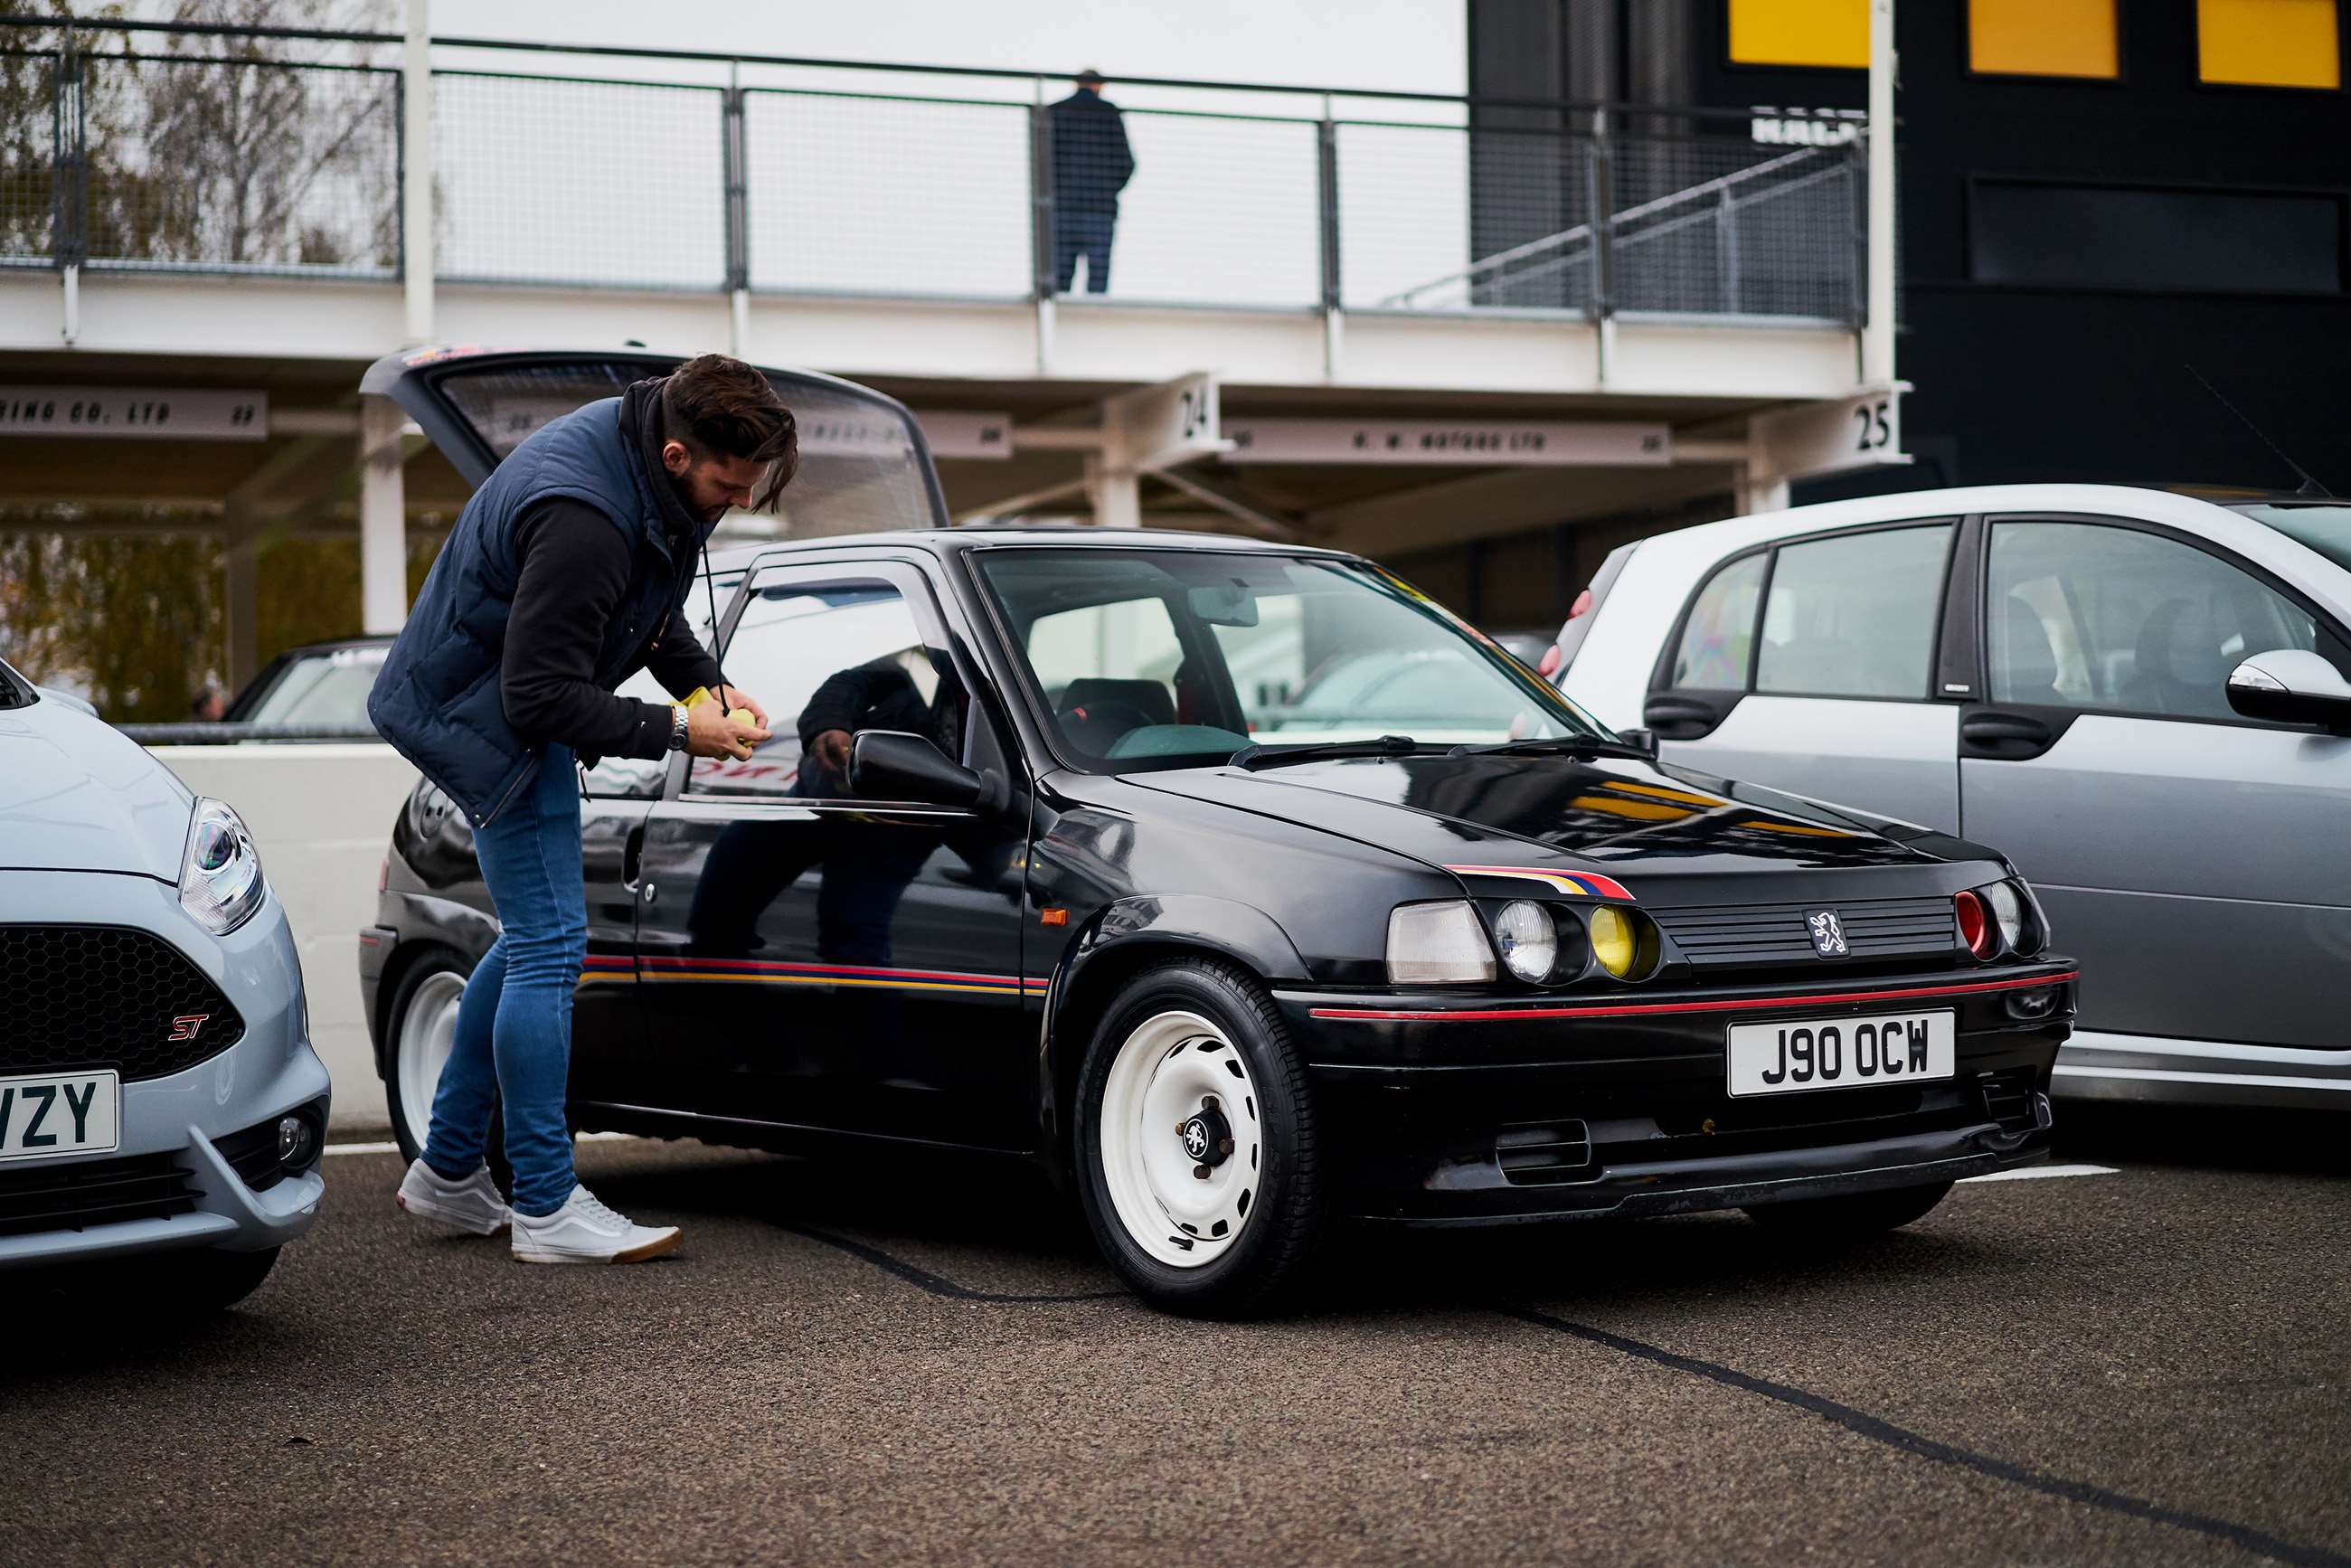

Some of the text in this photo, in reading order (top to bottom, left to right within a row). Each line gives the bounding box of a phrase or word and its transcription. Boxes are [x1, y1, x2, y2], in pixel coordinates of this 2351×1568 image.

[127, 401, 170, 425] LTD
[1181, 390, 1206, 439] 24
[1855, 401, 1891, 450] 25
[168, 1014, 209, 1041] ST
[1761, 1019, 1928, 1084] J90 OCW
